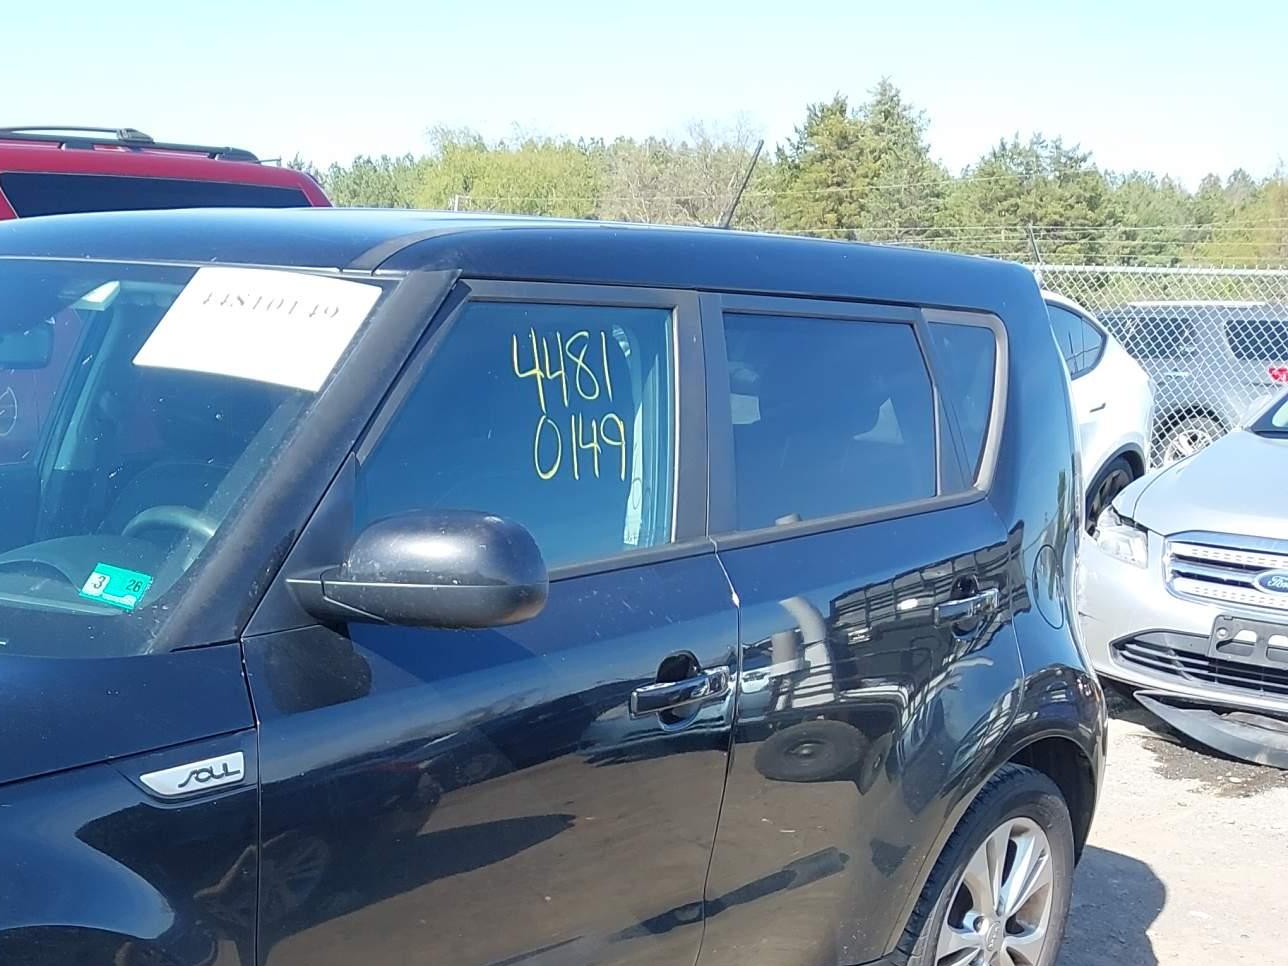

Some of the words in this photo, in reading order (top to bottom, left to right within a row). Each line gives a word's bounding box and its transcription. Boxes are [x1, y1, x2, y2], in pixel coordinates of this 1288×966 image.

[512, 327, 613, 414] 4481
[534, 412, 626, 481] 0149
[126, 579, 143, 593] 26
